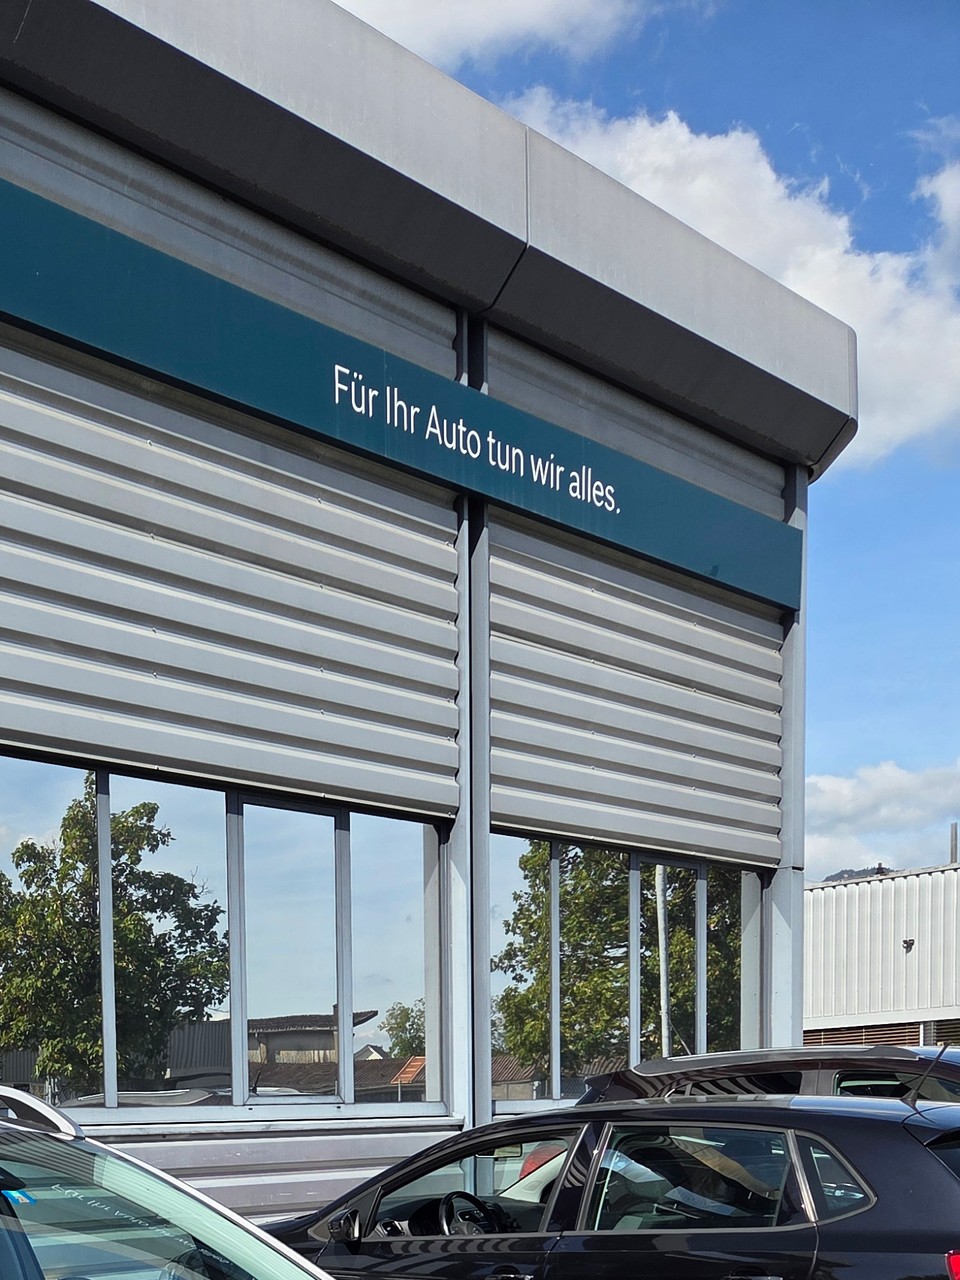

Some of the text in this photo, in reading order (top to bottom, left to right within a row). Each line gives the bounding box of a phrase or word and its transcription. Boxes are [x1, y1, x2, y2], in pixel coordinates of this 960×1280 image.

[333, 364, 622, 515] Für Ihr Auto tun wir alles.
